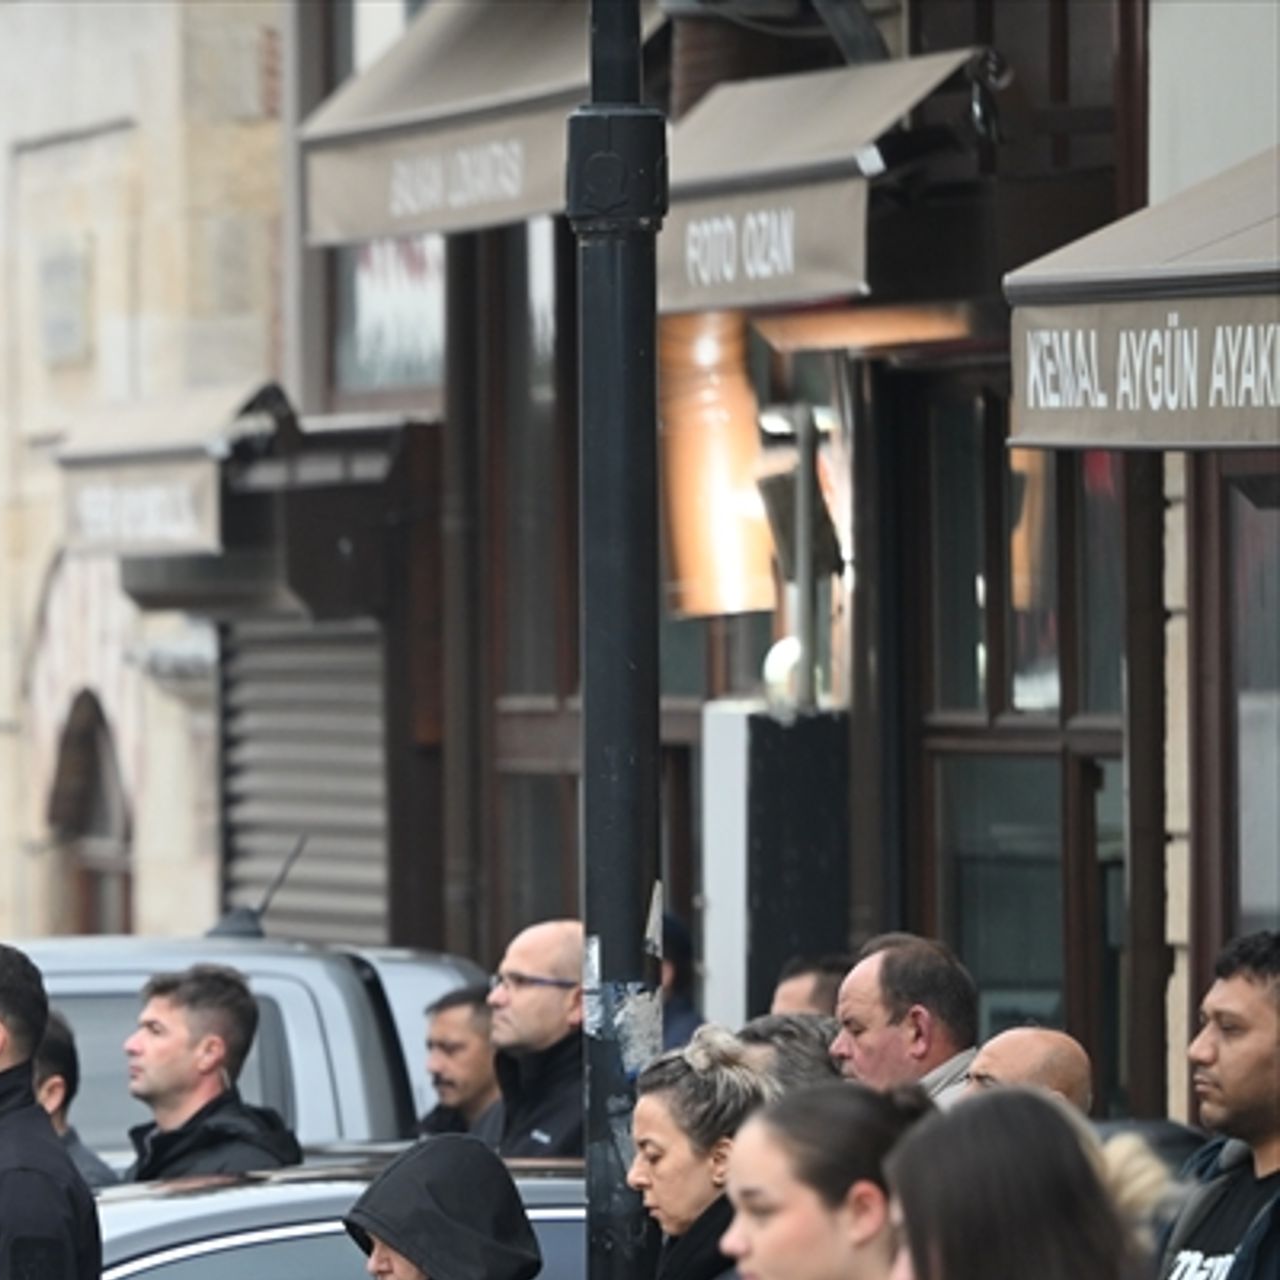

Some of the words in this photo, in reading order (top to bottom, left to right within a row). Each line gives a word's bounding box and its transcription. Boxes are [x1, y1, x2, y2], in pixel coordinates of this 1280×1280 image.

[743, 208, 794, 280] OZAN
[1026, 329, 1108, 409] KEMAL
[1116, 312, 1198, 410] AYGÜN
[1209, 324, 1280, 407] AYAK
